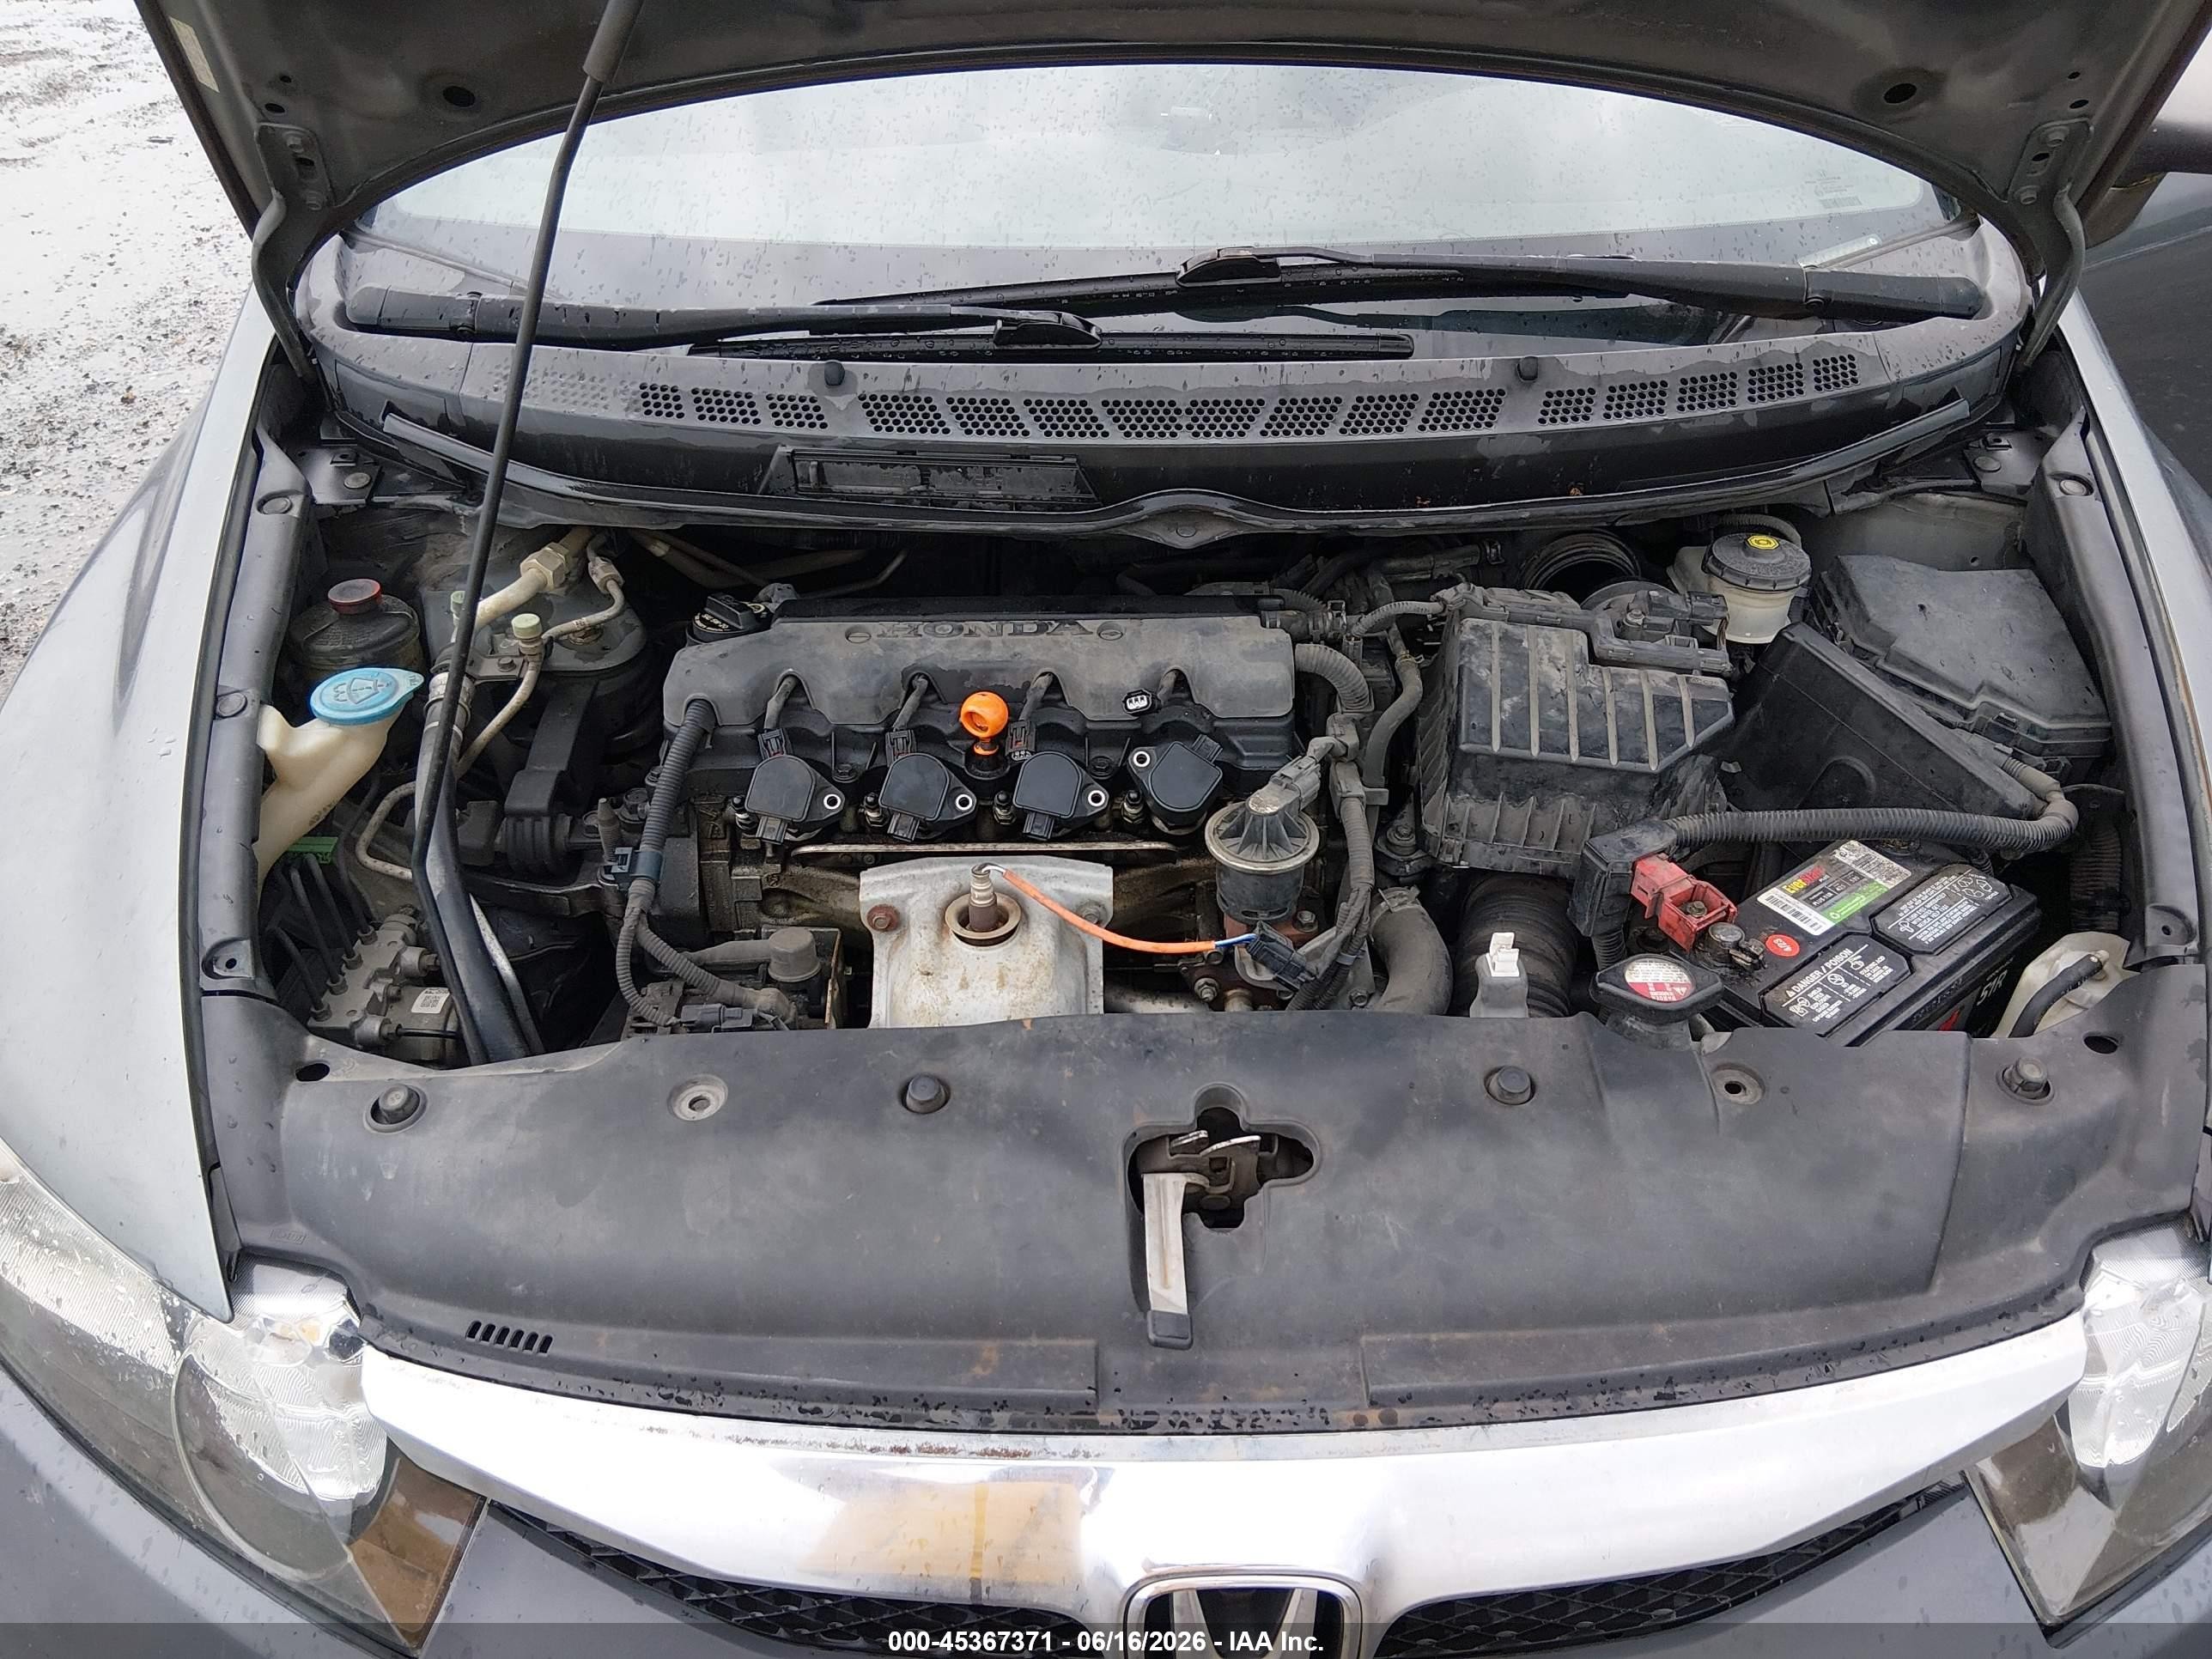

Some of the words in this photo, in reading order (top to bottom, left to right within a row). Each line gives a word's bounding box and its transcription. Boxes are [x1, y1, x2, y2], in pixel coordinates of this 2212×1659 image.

[877, 620, 1093, 639] HONDA
[1791, 969, 1821, 994] DANGER
[1824, 947, 1855, 969] POISON
